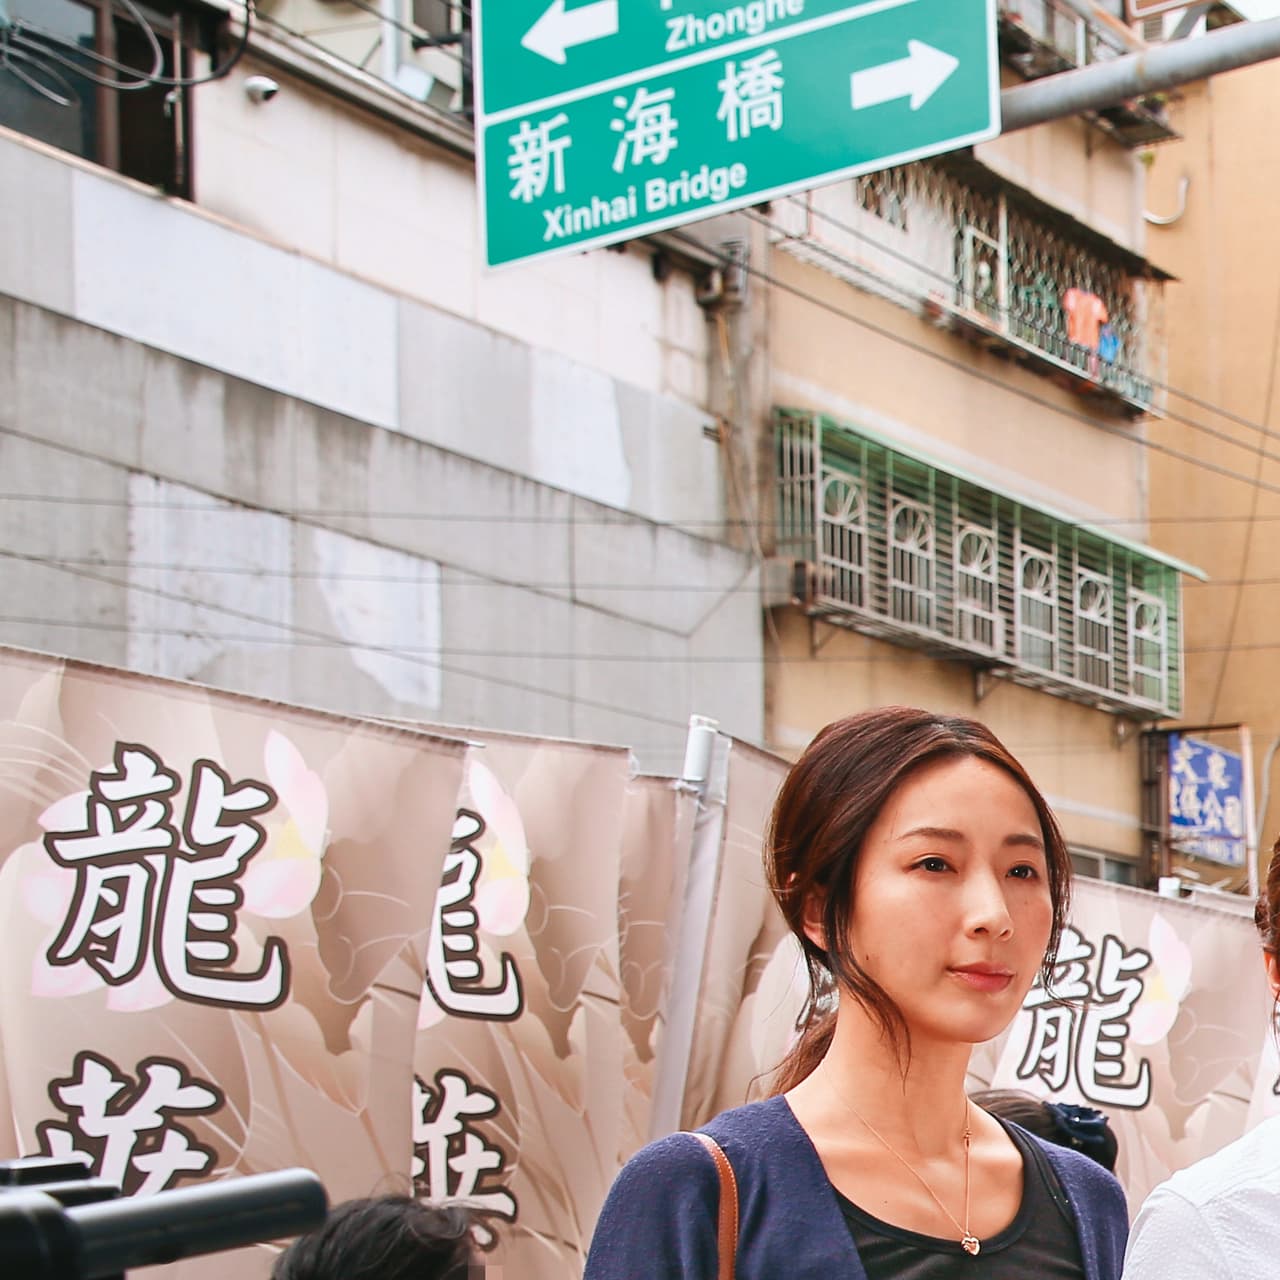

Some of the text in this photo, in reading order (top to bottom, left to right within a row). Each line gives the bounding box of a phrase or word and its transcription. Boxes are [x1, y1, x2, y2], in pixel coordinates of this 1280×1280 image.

[507, 49, 785, 203] 新海橋
[543, 159, 748, 242] Xinhai Bridge
